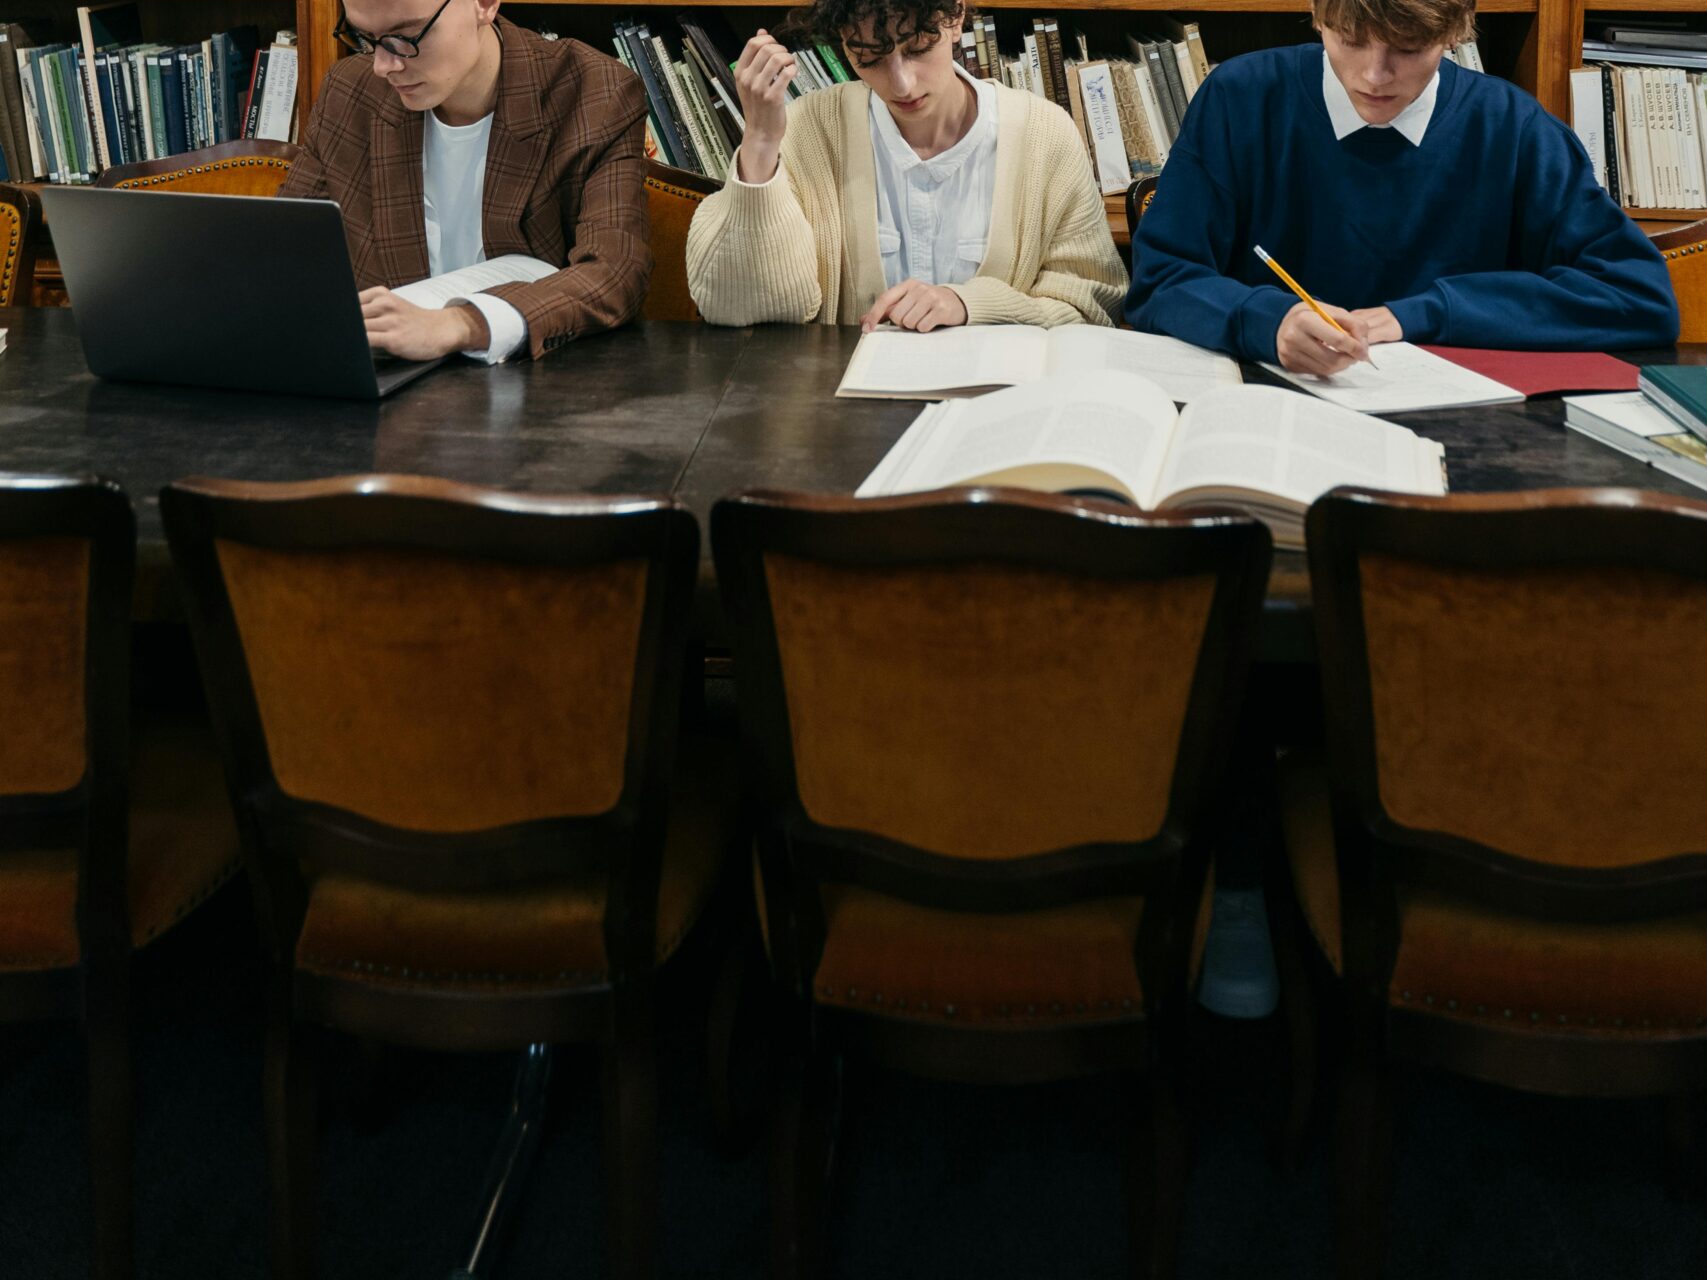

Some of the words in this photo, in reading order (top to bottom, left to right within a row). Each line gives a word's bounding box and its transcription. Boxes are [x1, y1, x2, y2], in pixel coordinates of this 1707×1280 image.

[1645, 82, 1654, 112] ЩУСЕВ
[1655, 82, 1663, 112] ЩУСЕВ
[1664, 82, 1672, 112] ЩУСЕВ
[247, 104, 258, 129] МОСТЫ
